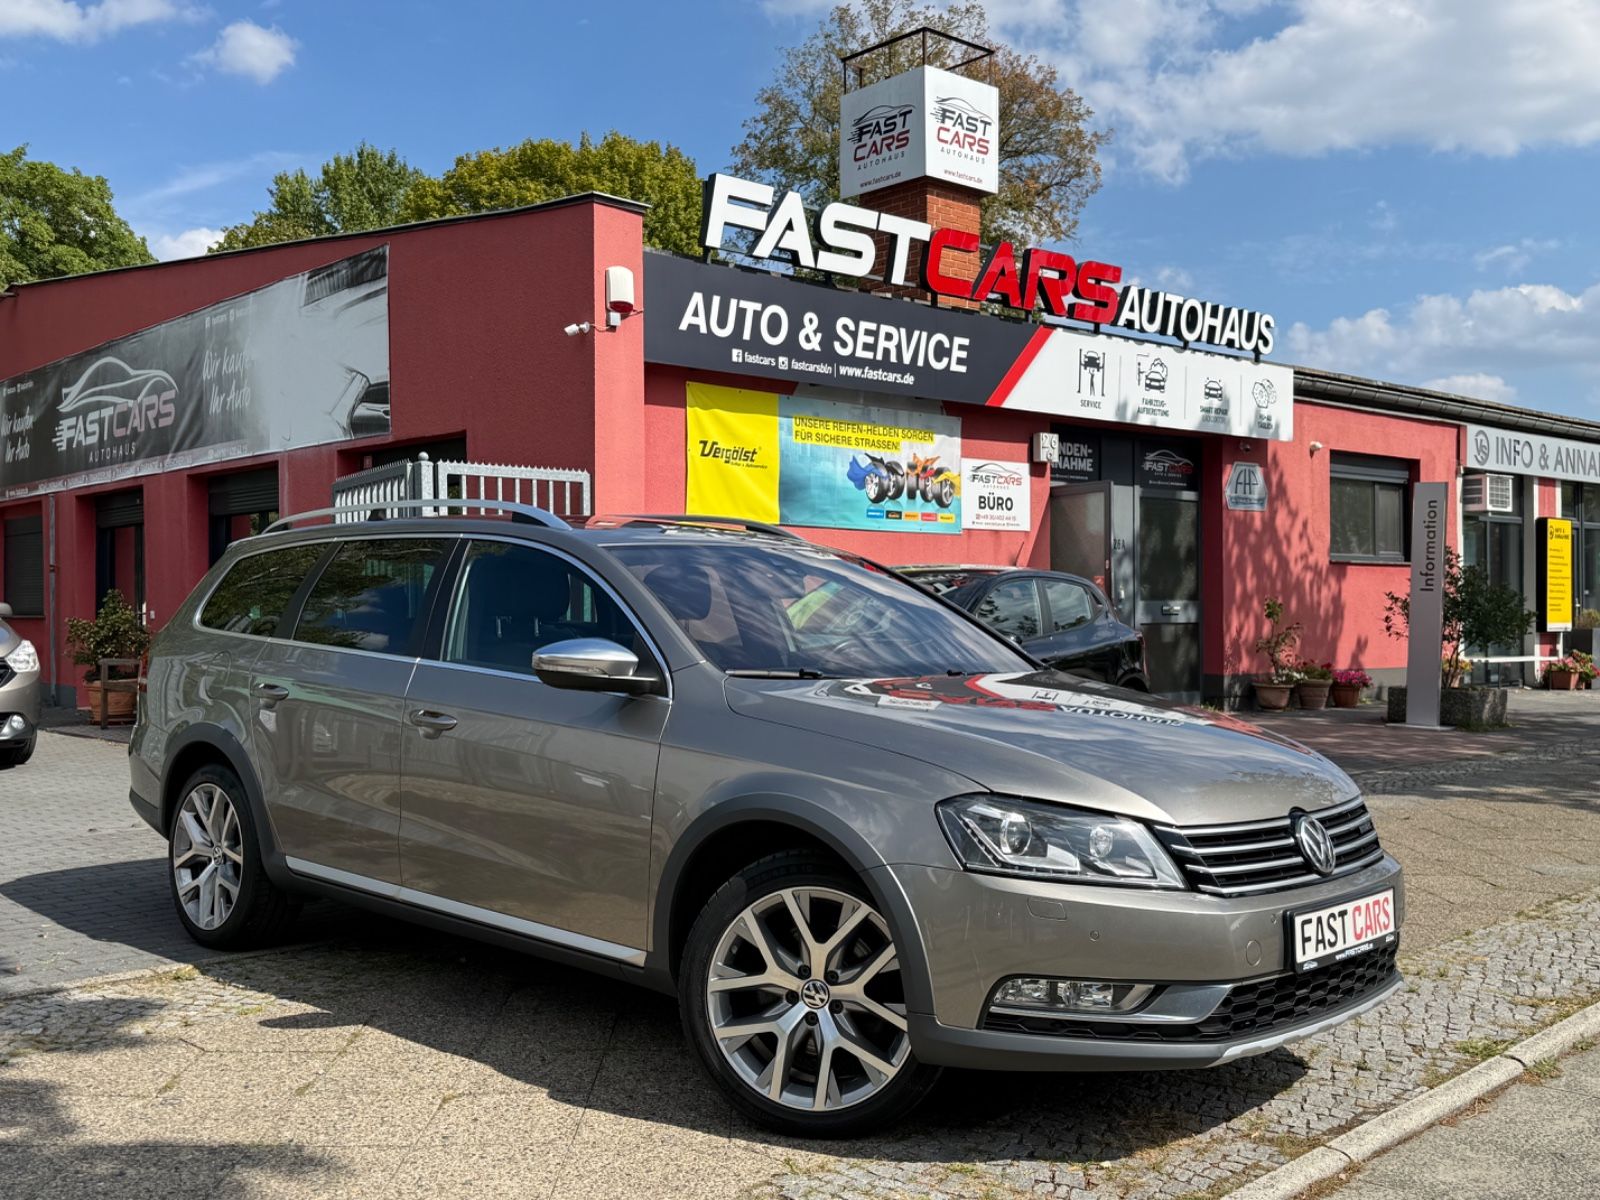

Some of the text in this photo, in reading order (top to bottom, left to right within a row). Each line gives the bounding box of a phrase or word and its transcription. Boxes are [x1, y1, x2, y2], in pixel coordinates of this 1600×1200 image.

[856, 108, 914, 143] FAST
[939, 106, 992, 137] FAST
[853, 129, 911, 163] CARS
[936, 126, 990, 156] CARS
[856, 150, 906, 171] AUTOHAUS
[940, 146, 987, 165] AUTOHAUS
[860, 170, 902, 188] www.fastcars.de
[944, 168, 984, 184] www.fastcars.de
[678, 291, 971, 374] AUTO & SERVICE
[1116, 285, 1275, 355] AUTOHAUS
[745, 352, 776, 367] fastcars
[839, 364, 915, 385] www.fastcars.de
[1080, 399, 1102, 409] SERVICE
[794, 416, 935, 442] UNSERE REIFEN-HELDEN SORGEN
[794, 430, 900, 450] FÜR SICHERE STRASSEN!
[88, 442, 137, 463] AUTOHAUS
[699, 440, 758, 464] Vergölst
[1495, 436, 1534, 469] INFO
[1538, 443, 1550, 471] &
[978, 492, 1014, 512] BÜRO
[1419, 499, 1438, 592] Information
[1300, 896, 1390, 956] FAST CARS
